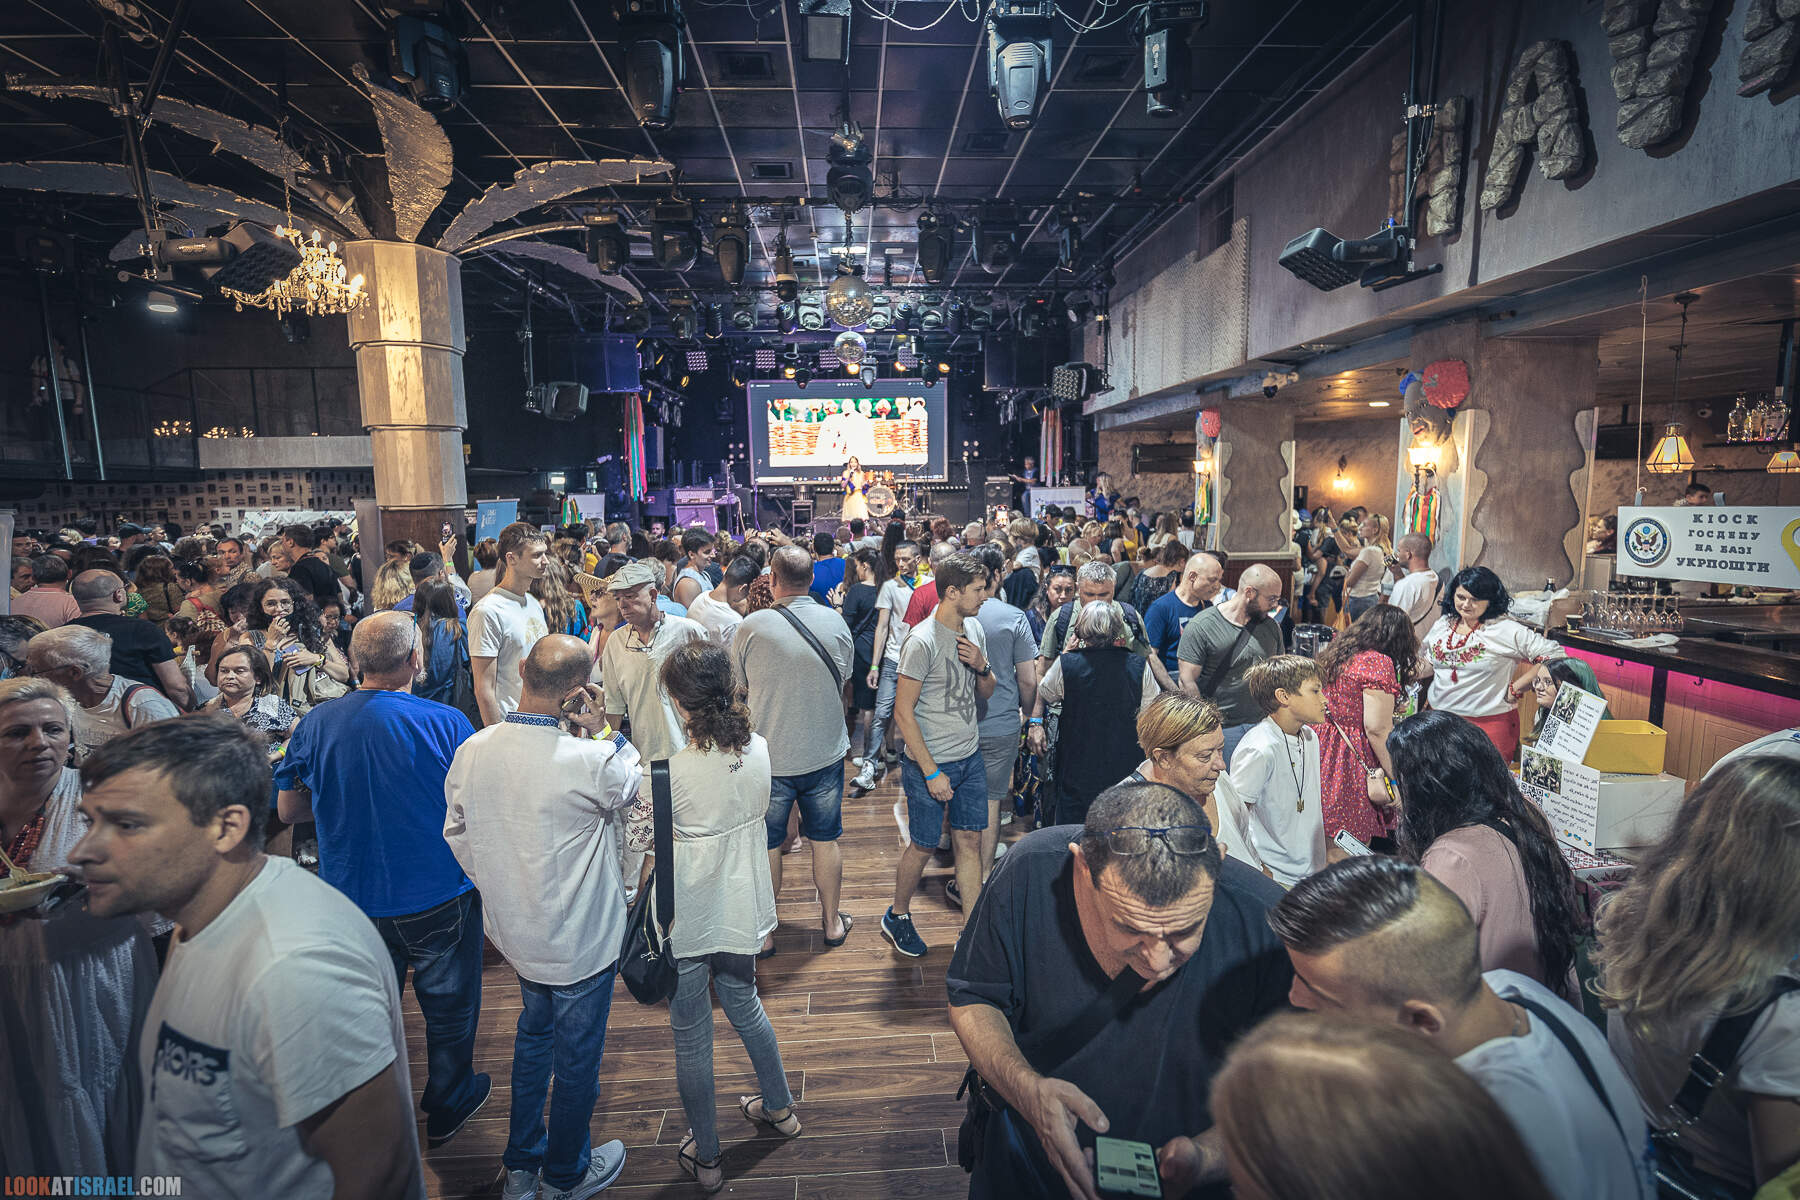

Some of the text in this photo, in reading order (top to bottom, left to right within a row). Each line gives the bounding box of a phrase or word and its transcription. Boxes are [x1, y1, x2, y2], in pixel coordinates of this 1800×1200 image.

[1692, 513, 1759, 525] КІОСК
[1695, 543, 1752, 555] НА БАЗІ
[1676, 557, 1770, 573] УКРПОШТИ
